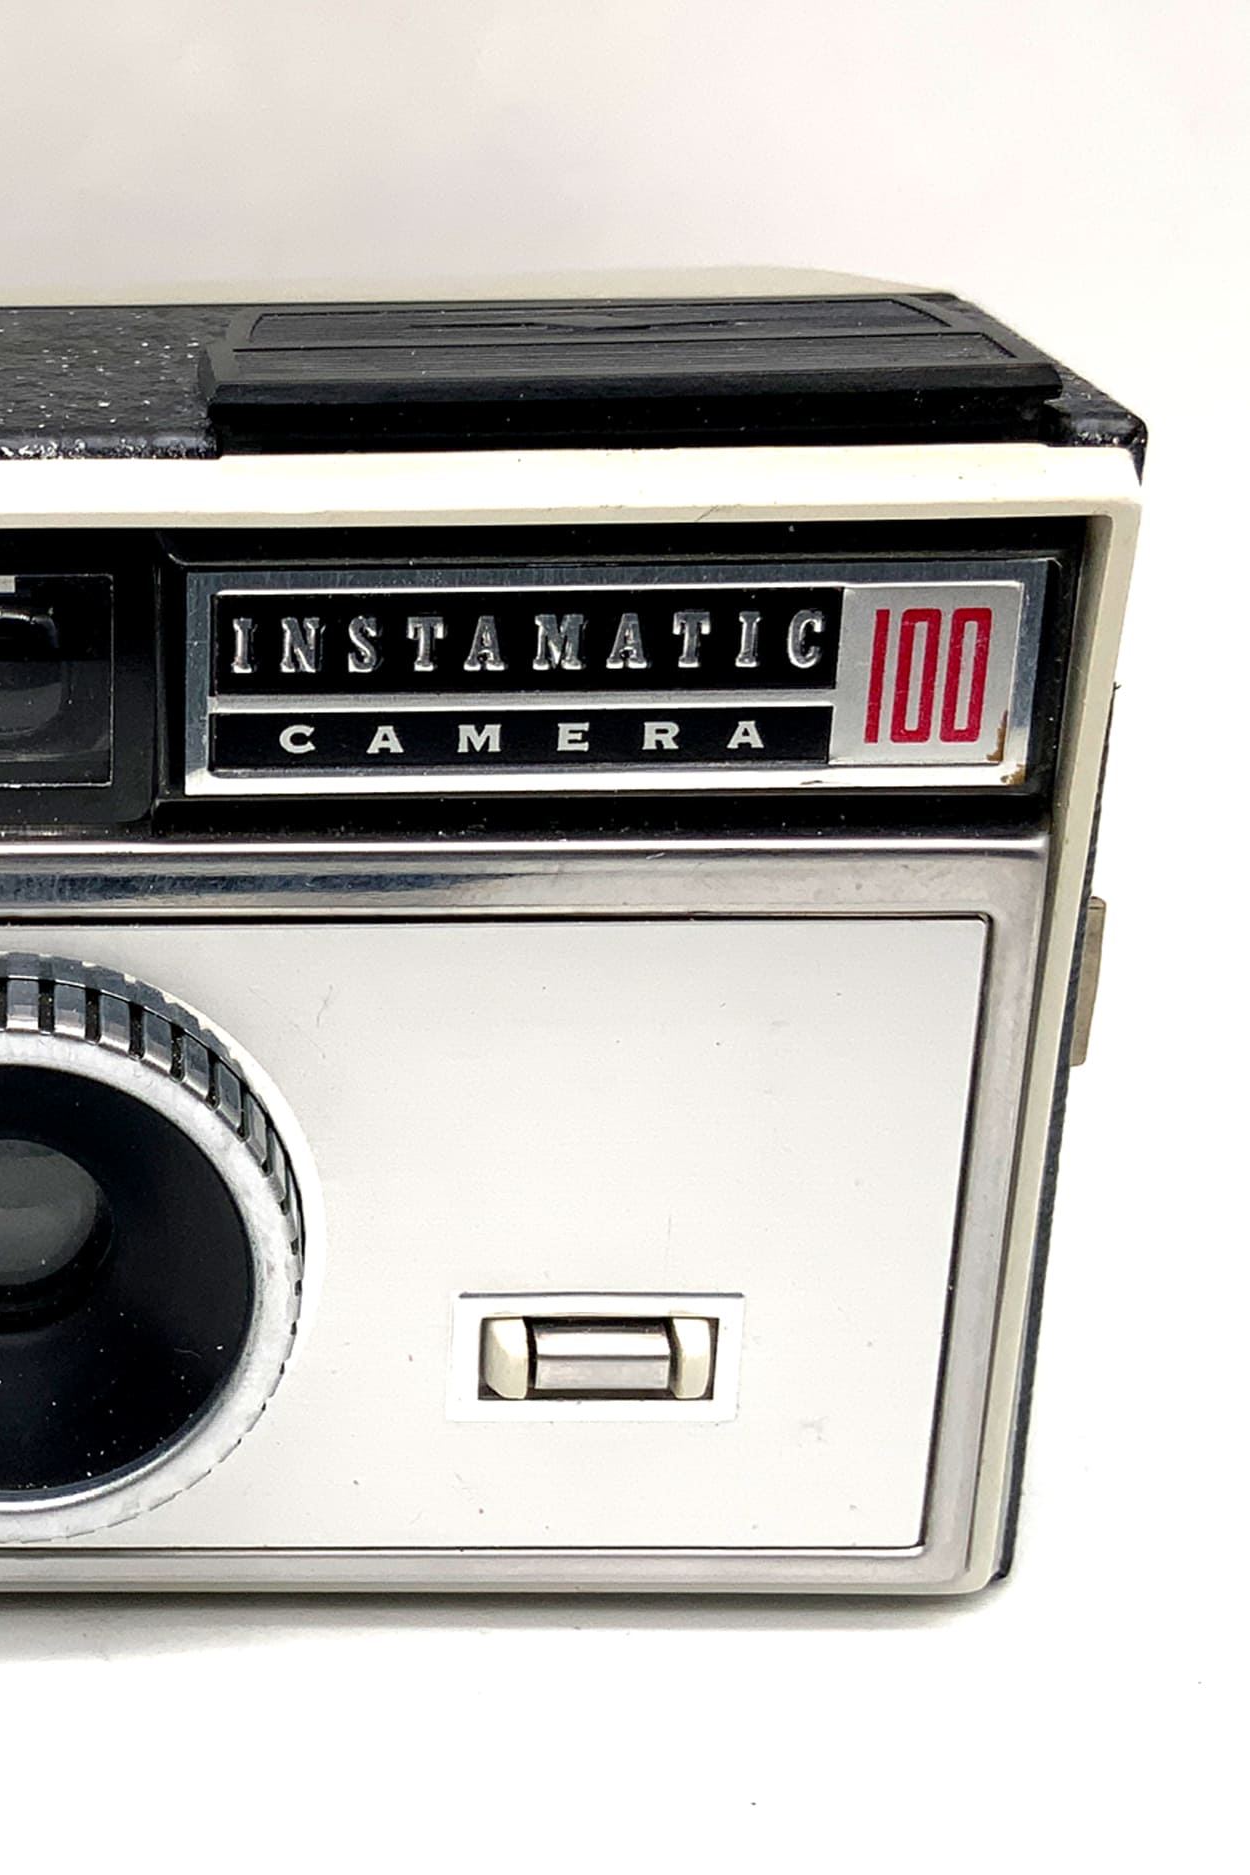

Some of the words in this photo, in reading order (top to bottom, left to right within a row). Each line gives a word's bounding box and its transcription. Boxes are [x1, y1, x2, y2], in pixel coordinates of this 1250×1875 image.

[231, 608, 826, 674] INSTAMATIC
[863, 606, 993, 745] 100
[278, 720, 767, 755] CAMERA
